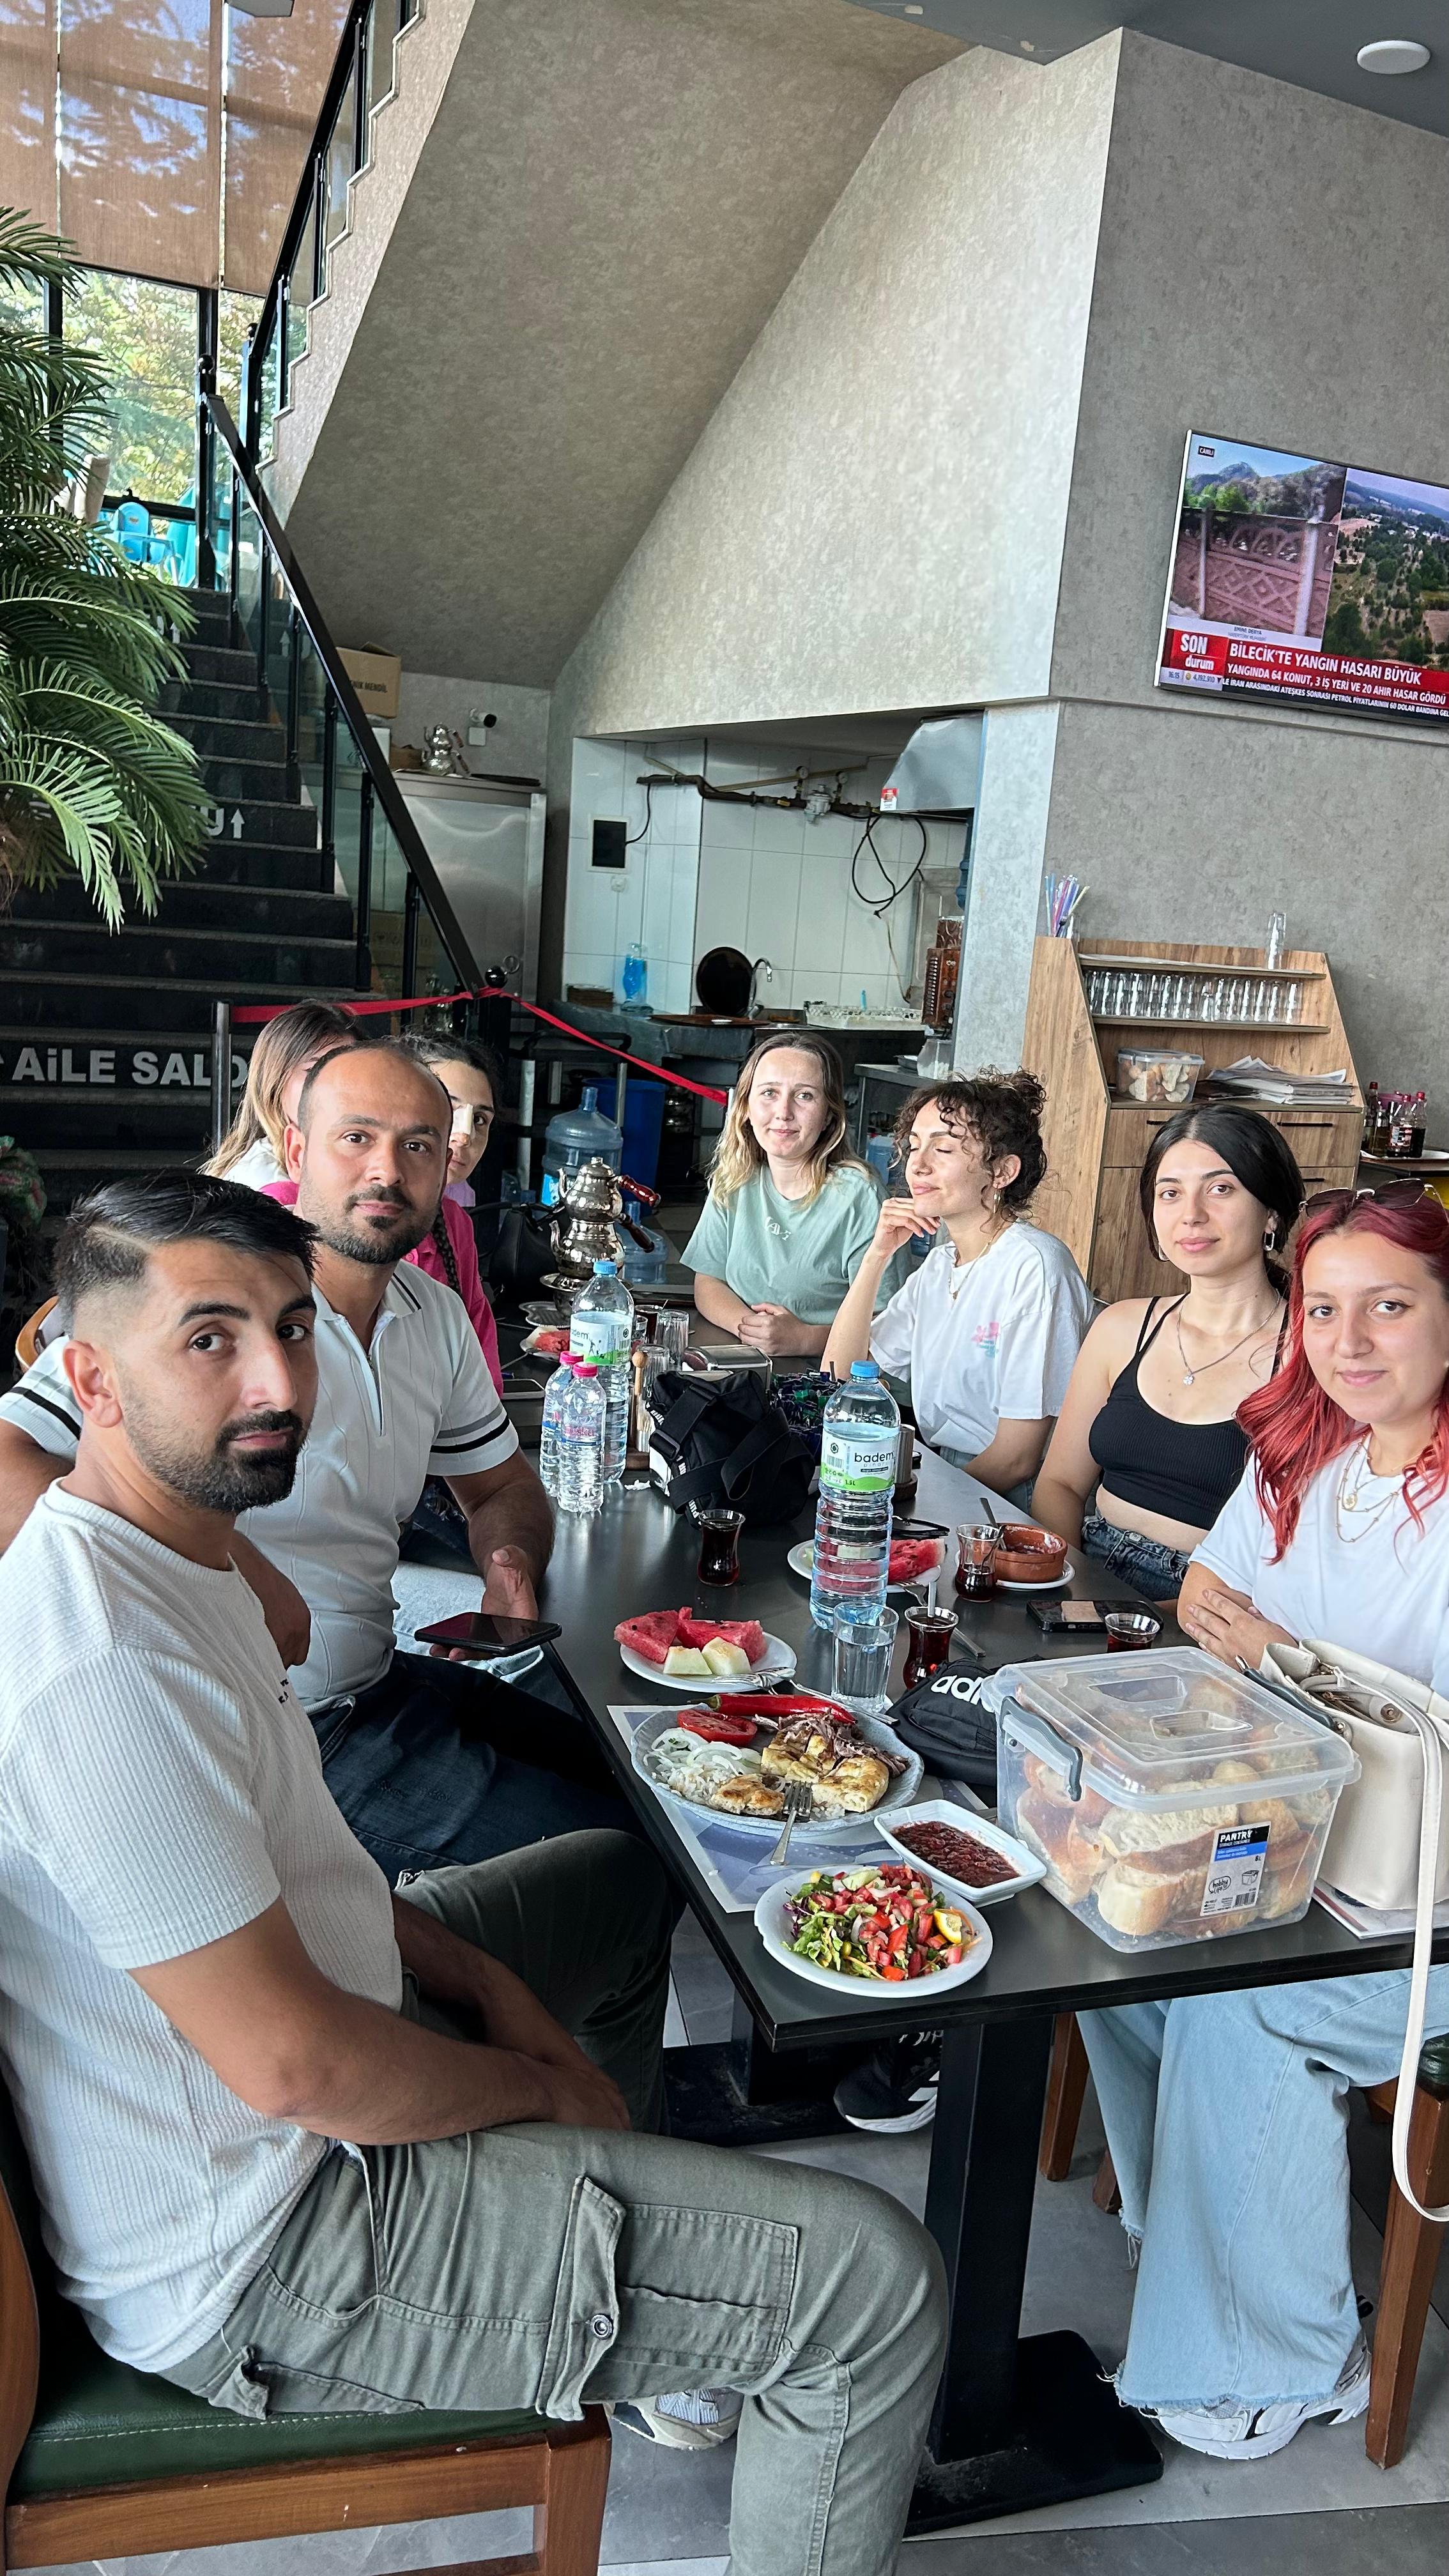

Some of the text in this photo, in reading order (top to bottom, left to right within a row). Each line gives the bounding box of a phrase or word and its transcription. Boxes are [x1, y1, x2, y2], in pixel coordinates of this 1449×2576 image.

[1181, 633, 1208, 654] SON
[1185, 655, 1214, 670] durum
[1229, 641, 1422, 685] BİLECİK'TE YANGIN HASARI BÜYÜK
[1227, 663, 1269, 679] YANGINDA
[1271, 670, 1282, 680] 64
[1284, 671, 1313, 687] KONUT,
[1315, 677, 1321, 687] 3
[1322, 675, 1330, 690] İŞ
[1331, 678, 1349, 691] YERİ
[1351, 682, 1361, 693] VE
[1362, 684, 1372, 694] 20
[1373, 686, 1391, 697] AHIR
[1393, 689, 1418, 701] HASAR
[1419, 691, 1446, 705] GÖRDÜ
[854, 1452, 894, 1462] badem
[1220, 1830, 1252, 1843] PANTRY
